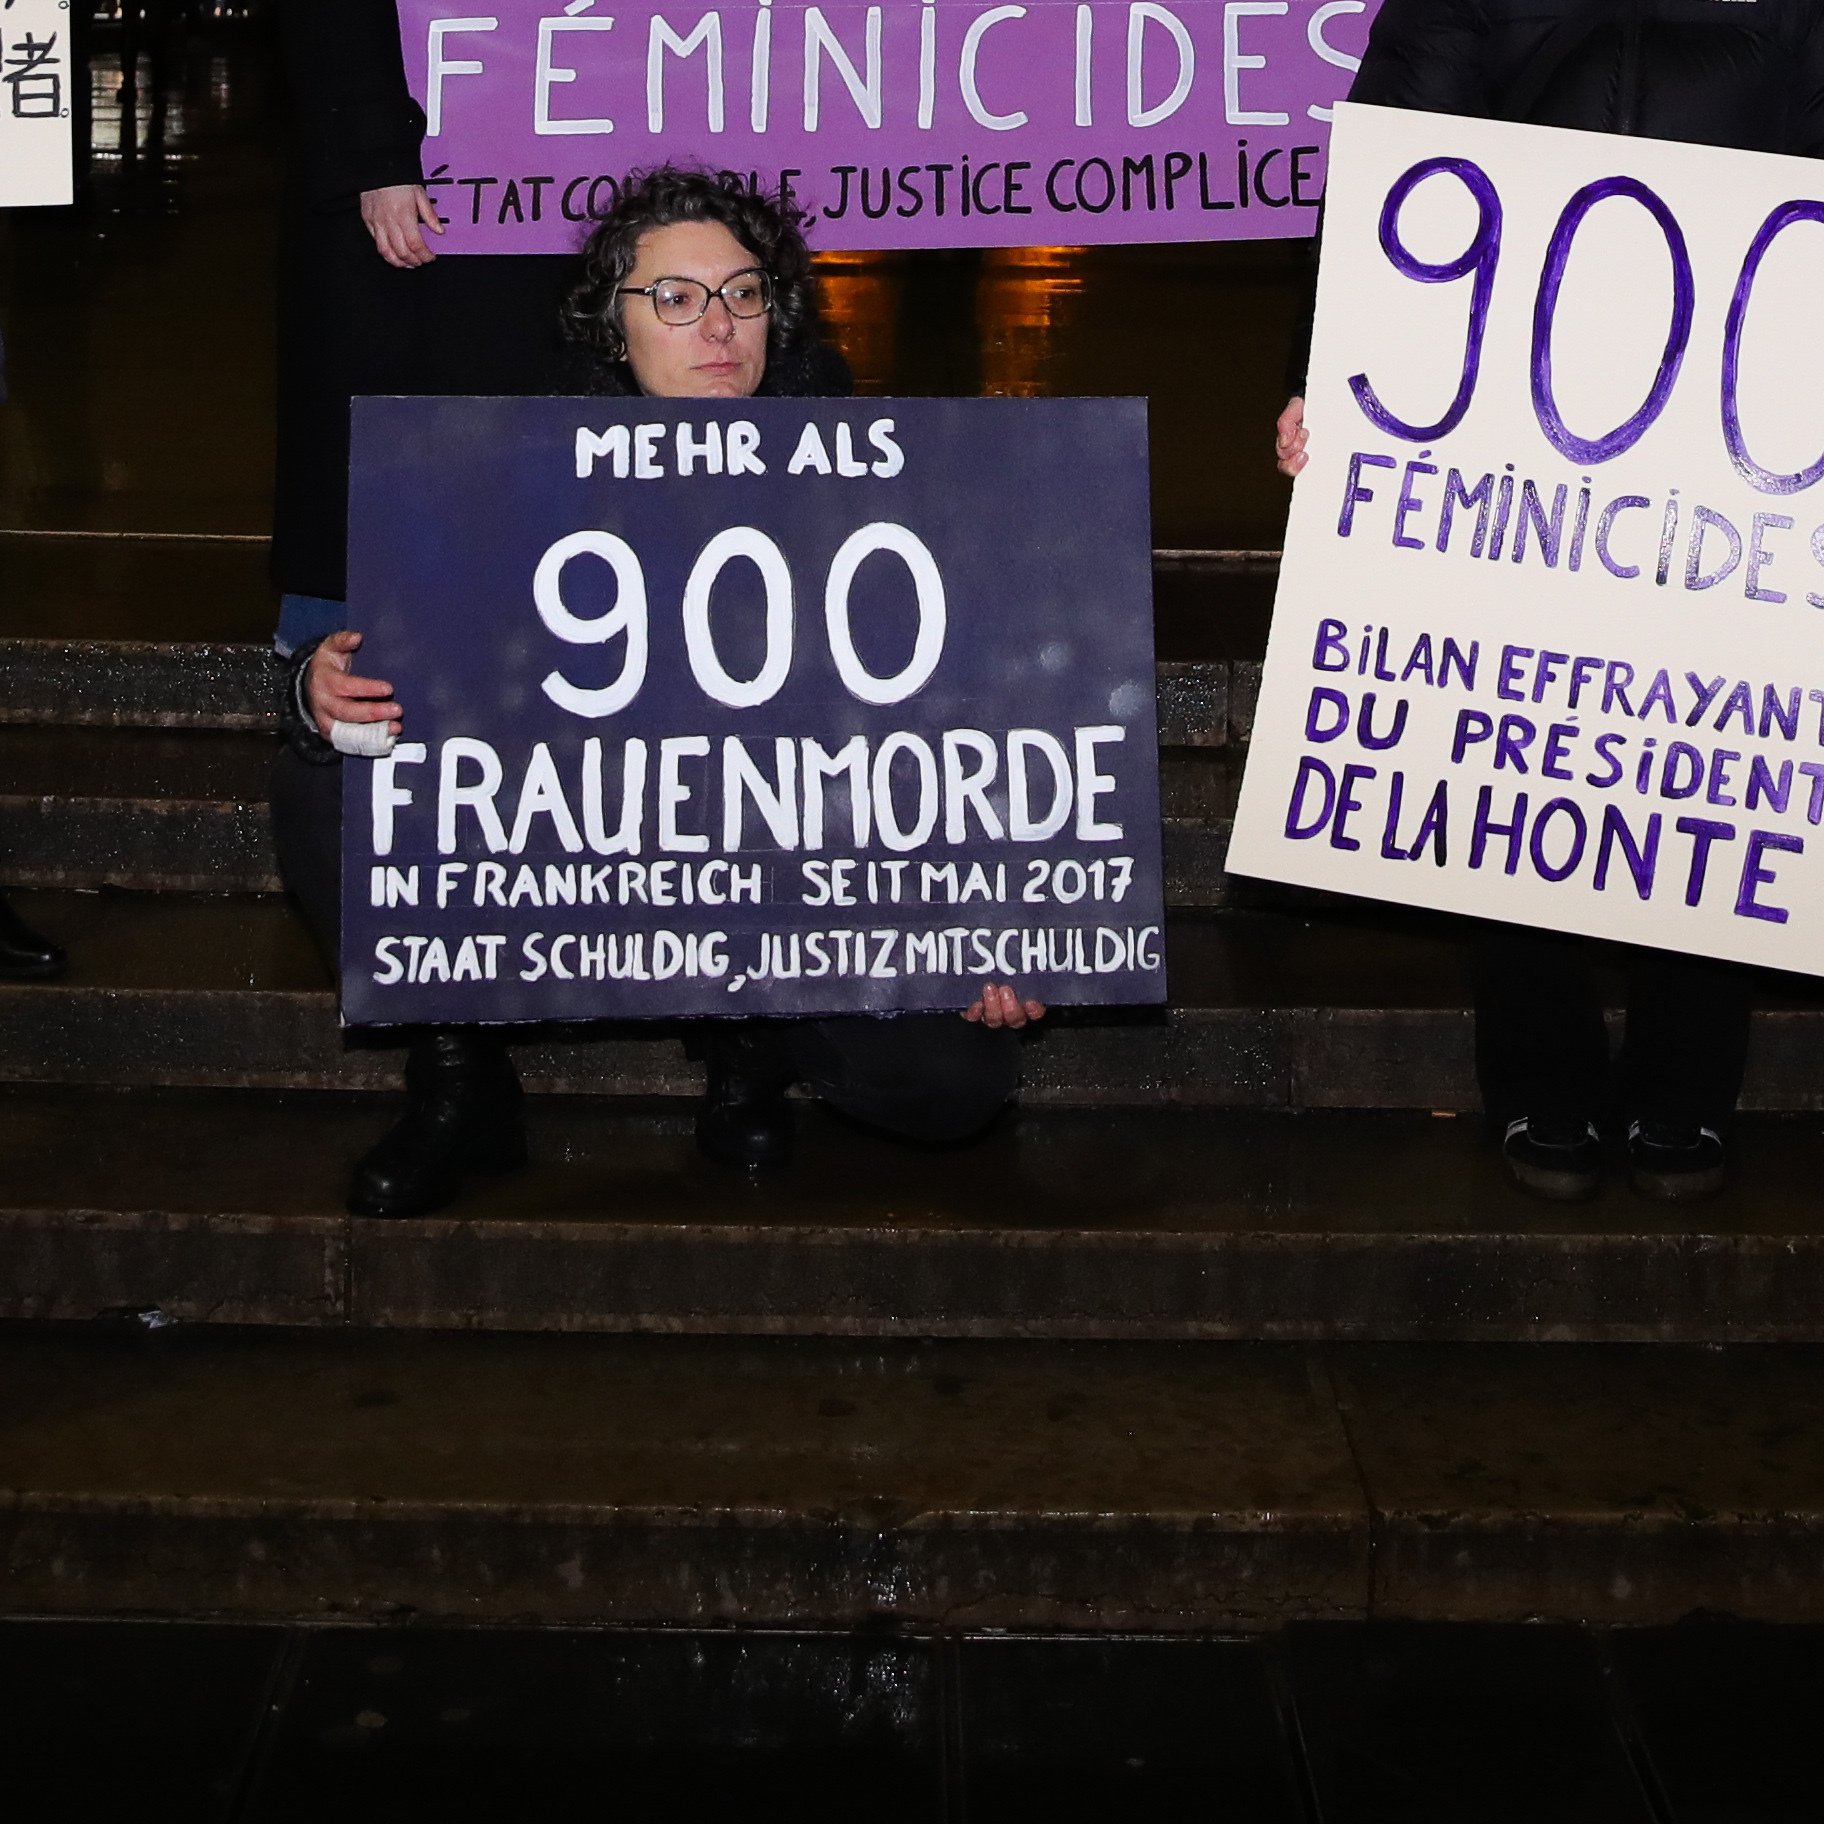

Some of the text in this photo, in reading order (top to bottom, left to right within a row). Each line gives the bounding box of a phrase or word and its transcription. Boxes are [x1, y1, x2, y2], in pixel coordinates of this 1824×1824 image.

[422, 162, 558, 226] ÉTAT
[822, 153, 1034, 221] JUSTICE
[1045, 137, 1323, 214] COMPLICE
[576, 419, 904, 479] MEHR ALS
[534, 522, 946, 718] 900
[1311, 618, 1481, 693] BILAN
[1304, 687, 1410, 750] DU
[370, 725, 1126, 855] FRAUENMORDE
[371, 857, 1134, 909] IN FRANKREICH SEIT MAI 2017
[1469, 783, 1806, 926] HONTE
[373, 935, 506, 984] STAAT
[747, 929, 898, 979] JUSTIZ
[906, 927, 1160, 975] MITSCHULDIG
